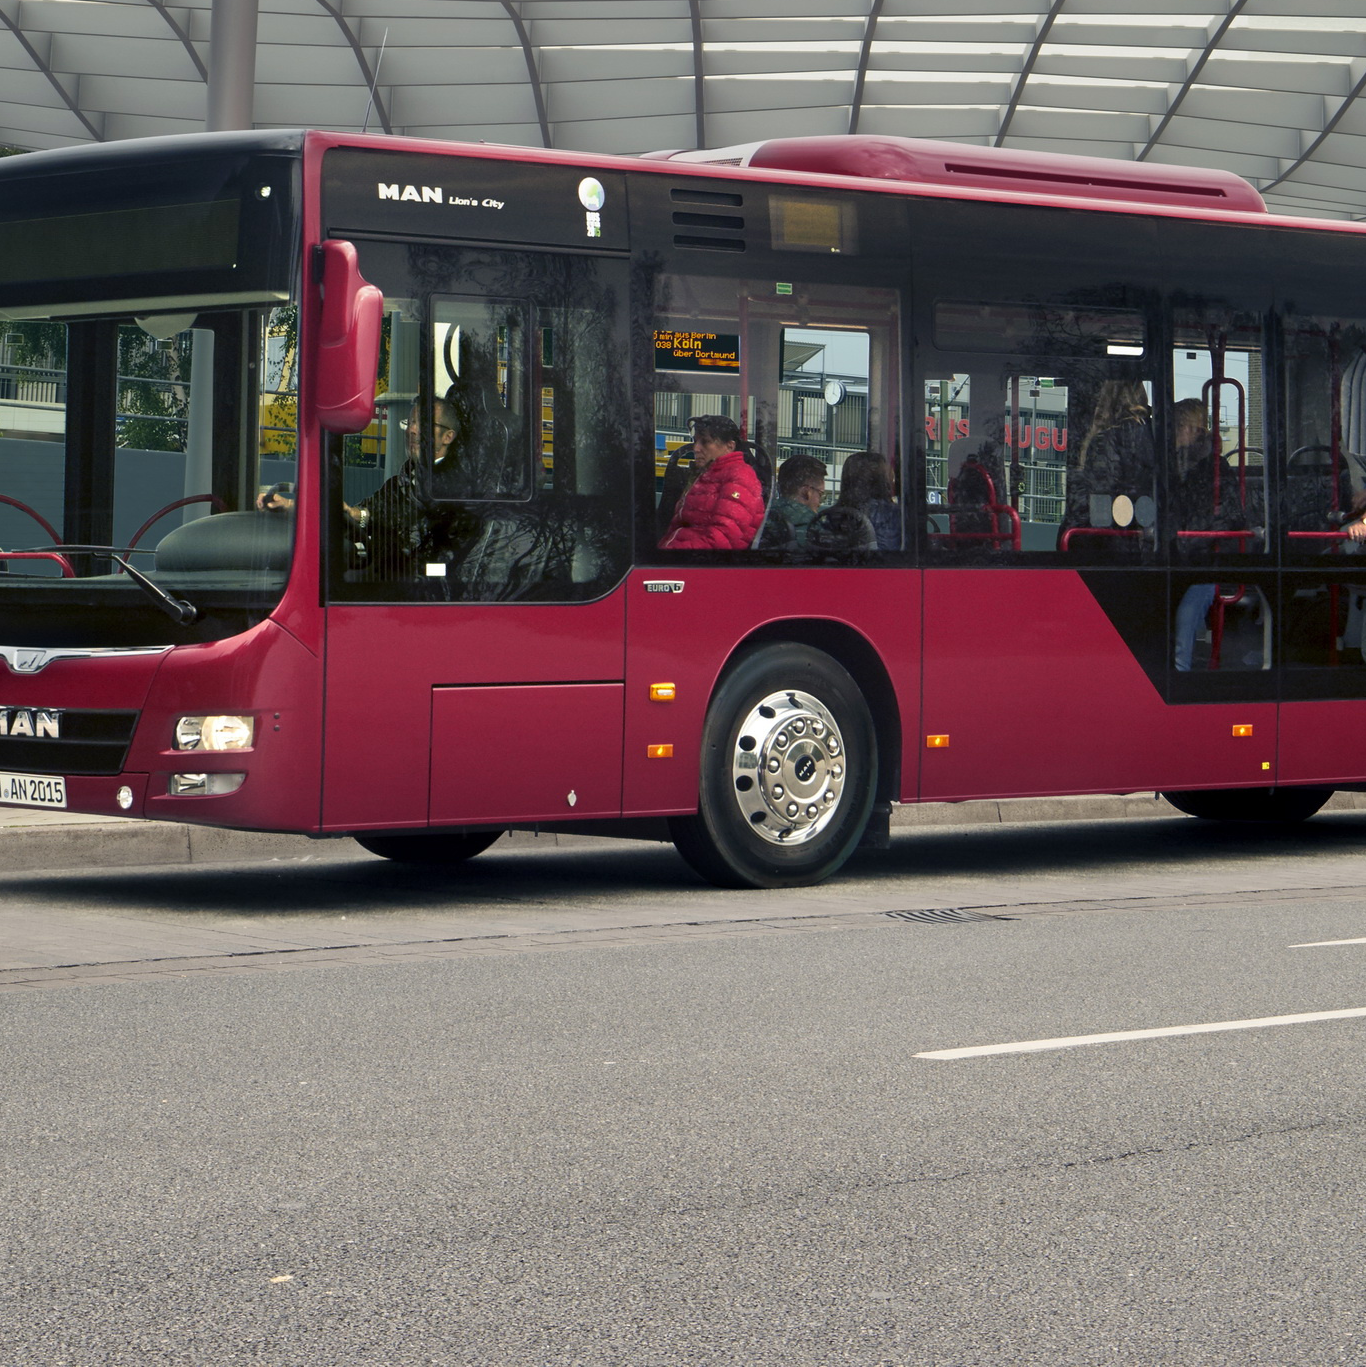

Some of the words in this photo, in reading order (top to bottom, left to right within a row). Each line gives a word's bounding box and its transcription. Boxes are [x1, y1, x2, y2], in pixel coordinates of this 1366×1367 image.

[378, 183, 443, 204] MAN
[449, 196, 478, 206] Lion's
[482, 198, 505, 210] City
[655, 340, 672, 349] 038
[673, 337, 702, 349] Köln
[673, 350, 693, 358] über
[695, 350, 736, 359] Dortmund
[647, 584, 670, 592] EURO
